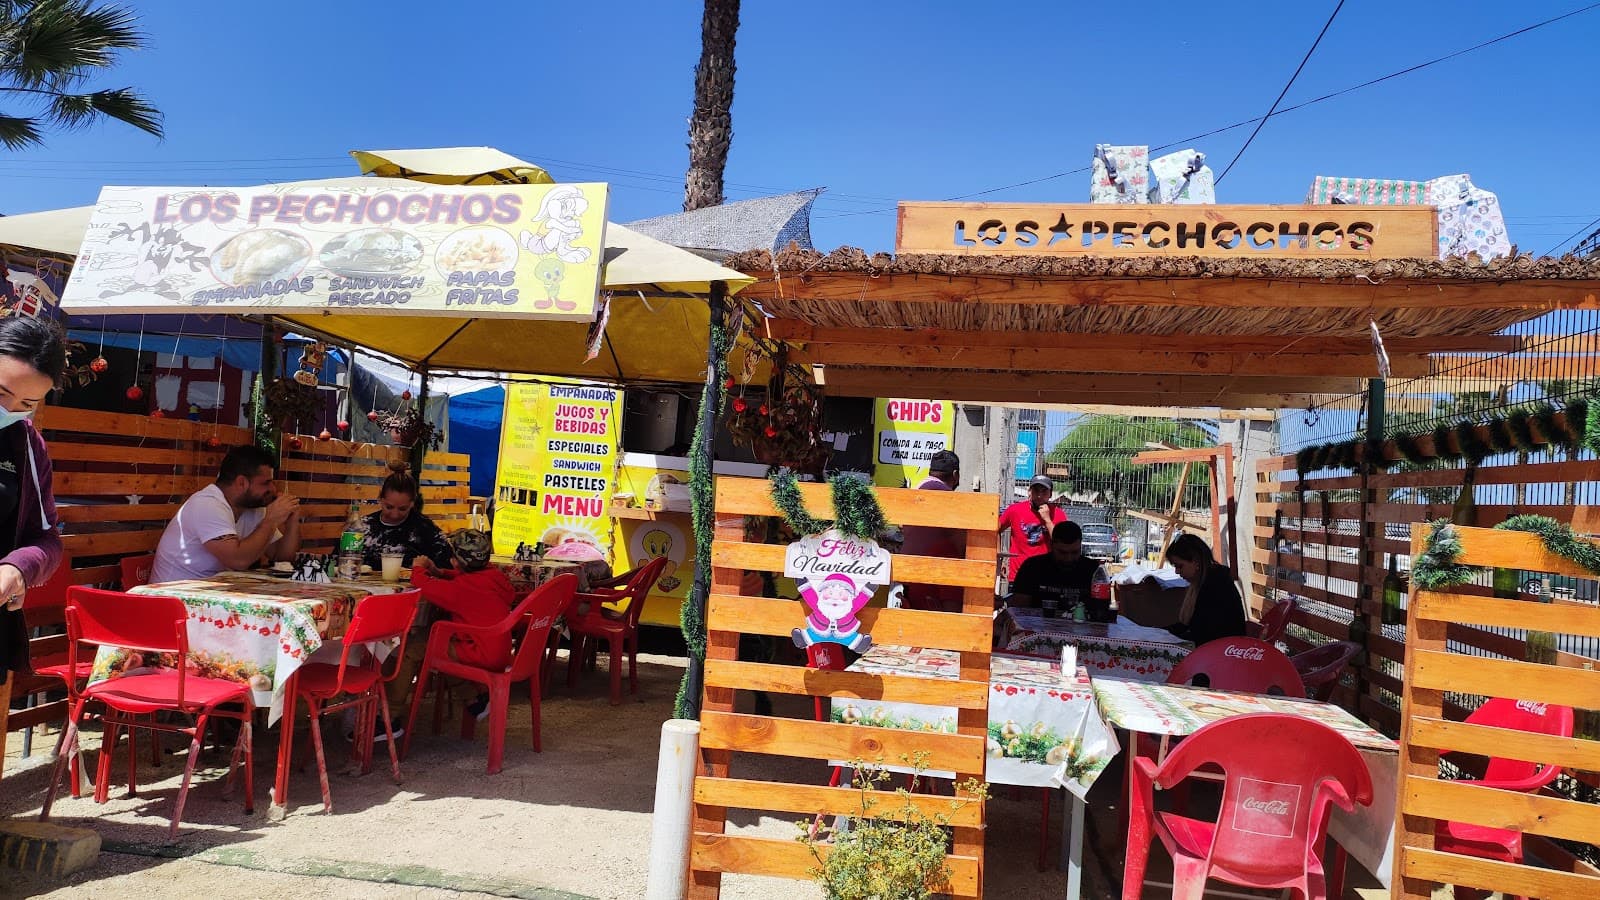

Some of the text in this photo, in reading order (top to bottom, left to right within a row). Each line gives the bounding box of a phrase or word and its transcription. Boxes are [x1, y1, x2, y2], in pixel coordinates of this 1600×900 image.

[153, 193, 522, 224] LOS PECHOCHOS
[954, 219, 1374, 250] LOS PECHOCHOS
[328, 275, 424, 291] SANDWICH
[447, 270, 516, 287] PAPAS
[192, 275, 314, 306] EMPANADAS
[328, 290, 411, 306] PESCADO
[550, 386, 616, 401] EMPANADAS
[555, 404, 608, 420] JUGOS Y
[887, 401, 942, 423] CHIPS
[555, 419, 606, 434] BEBIDAS
[548, 440, 608, 455] ESPECIALES
[882, 438, 944, 450] COMIDA AL PASO
[891, 450, 932, 460] PARA LLEVA
[553, 459, 601, 472] SANDWICH
[544, 474, 606, 491] PASTELES
[543, 494, 603, 517] MENÚ
[816, 539, 866, 559] Feliz
[793, 555, 884, 576] Navidad
